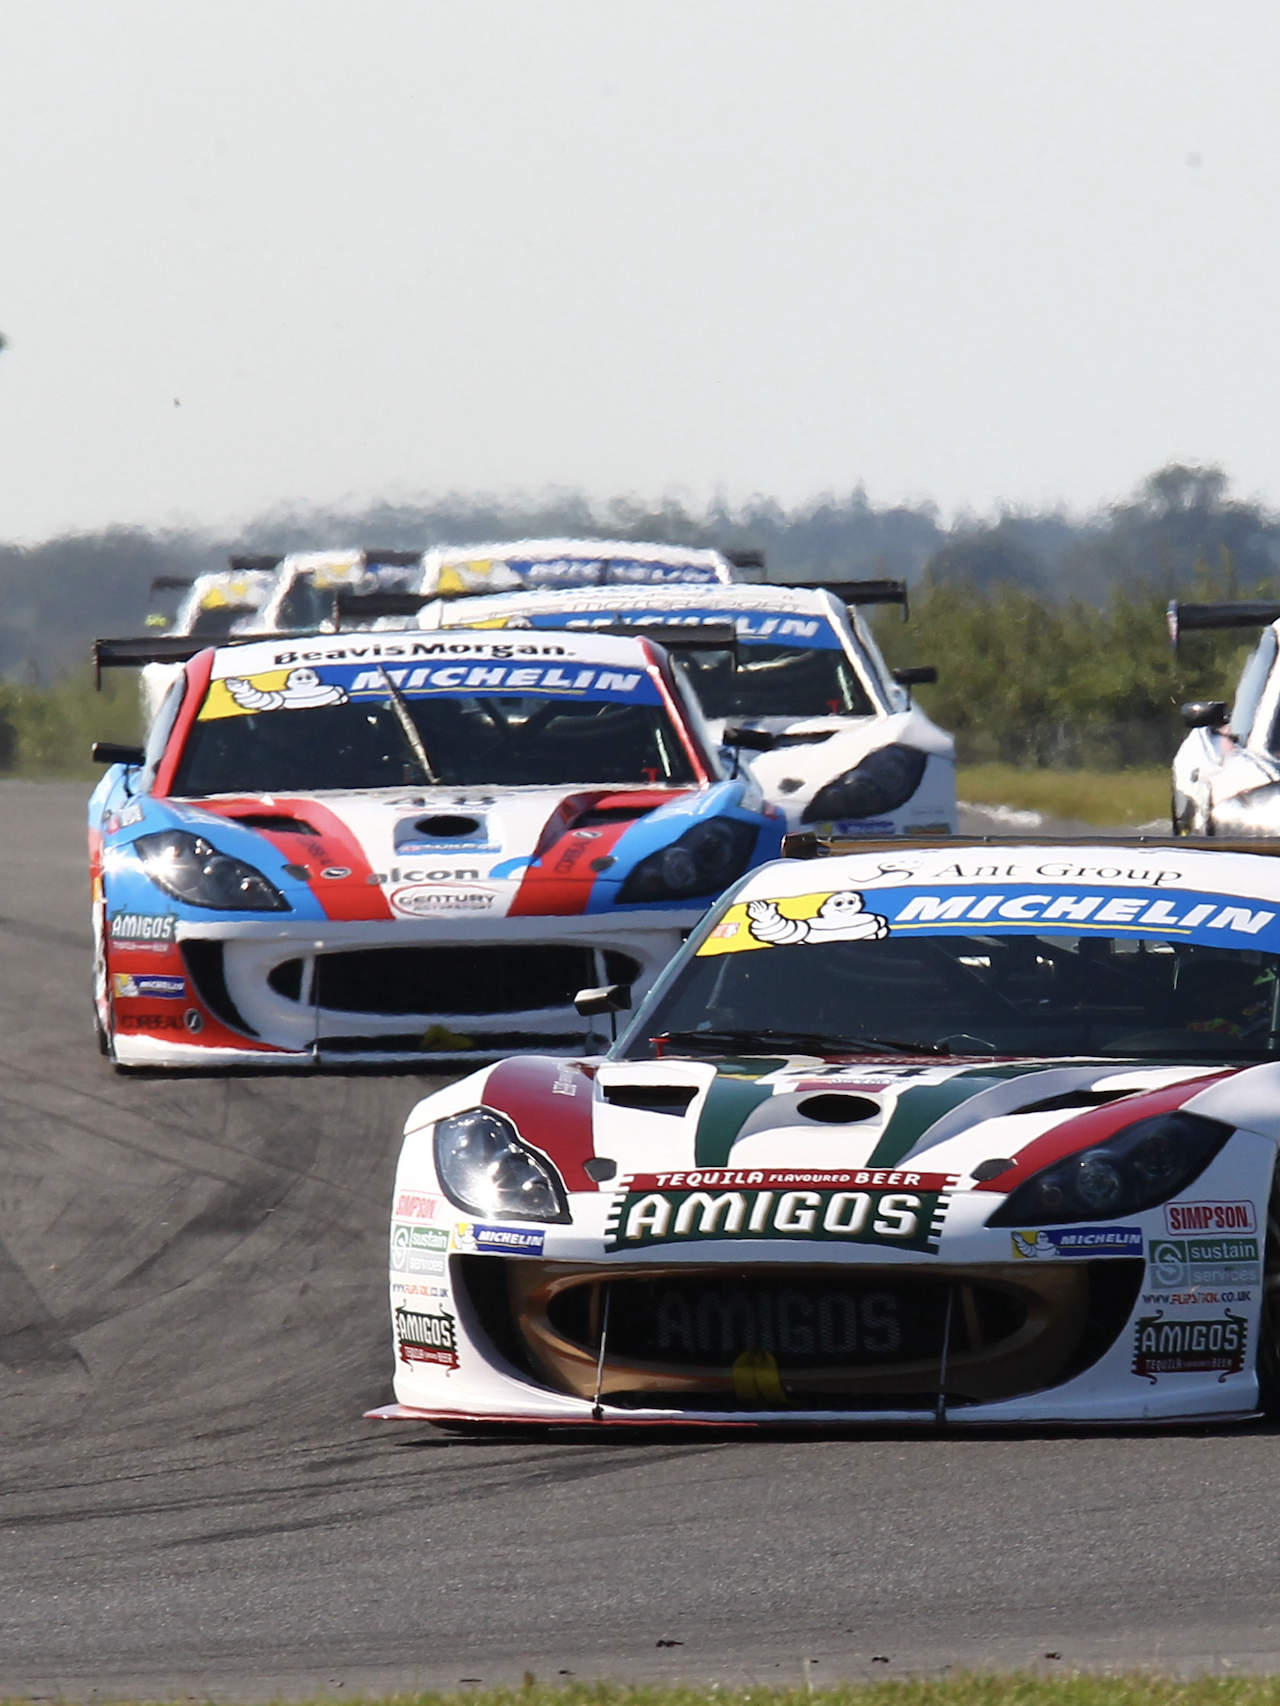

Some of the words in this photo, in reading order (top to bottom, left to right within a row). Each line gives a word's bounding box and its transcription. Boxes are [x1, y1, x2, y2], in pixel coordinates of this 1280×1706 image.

[350, 666, 643, 691] MICHELIN
[367, 868, 479, 885] alcon
[932, 863, 1019, 879] Ant
[1036, 862, 1184, 887] Group
[398, 894, 496, 905] CENTURY
[111, 914, 175, 938] AMIGOS
[894, 894, 1277, 935] MICHELIN
[656, 1171, 764, 1187] TEQUILA
[768, 1173, 850, 1184] FLAVOURED
[853, 1171, 922, 1187] BEER
[625, 1191, 923, 1240] AMIGOS
[1169, 1205, 1249, 1231] SIMPSON
[410, 1227, 448, 1249] sustain
[478, 1230, 544, 1247] MICHELIN
[1060, 1233, 1142, 1245] MICHELIN
[1191, 1241, 1256, 1259] sustain
[408, 1256, 445, 1273] services
[1192, 1267, 1257, 1283] services
[399, 1312, 451, 1348] AMIGOS
[658, 1289, 900, 1353] AMIGOS
[1142, 1323, 1239, 1353] AMIGOS
